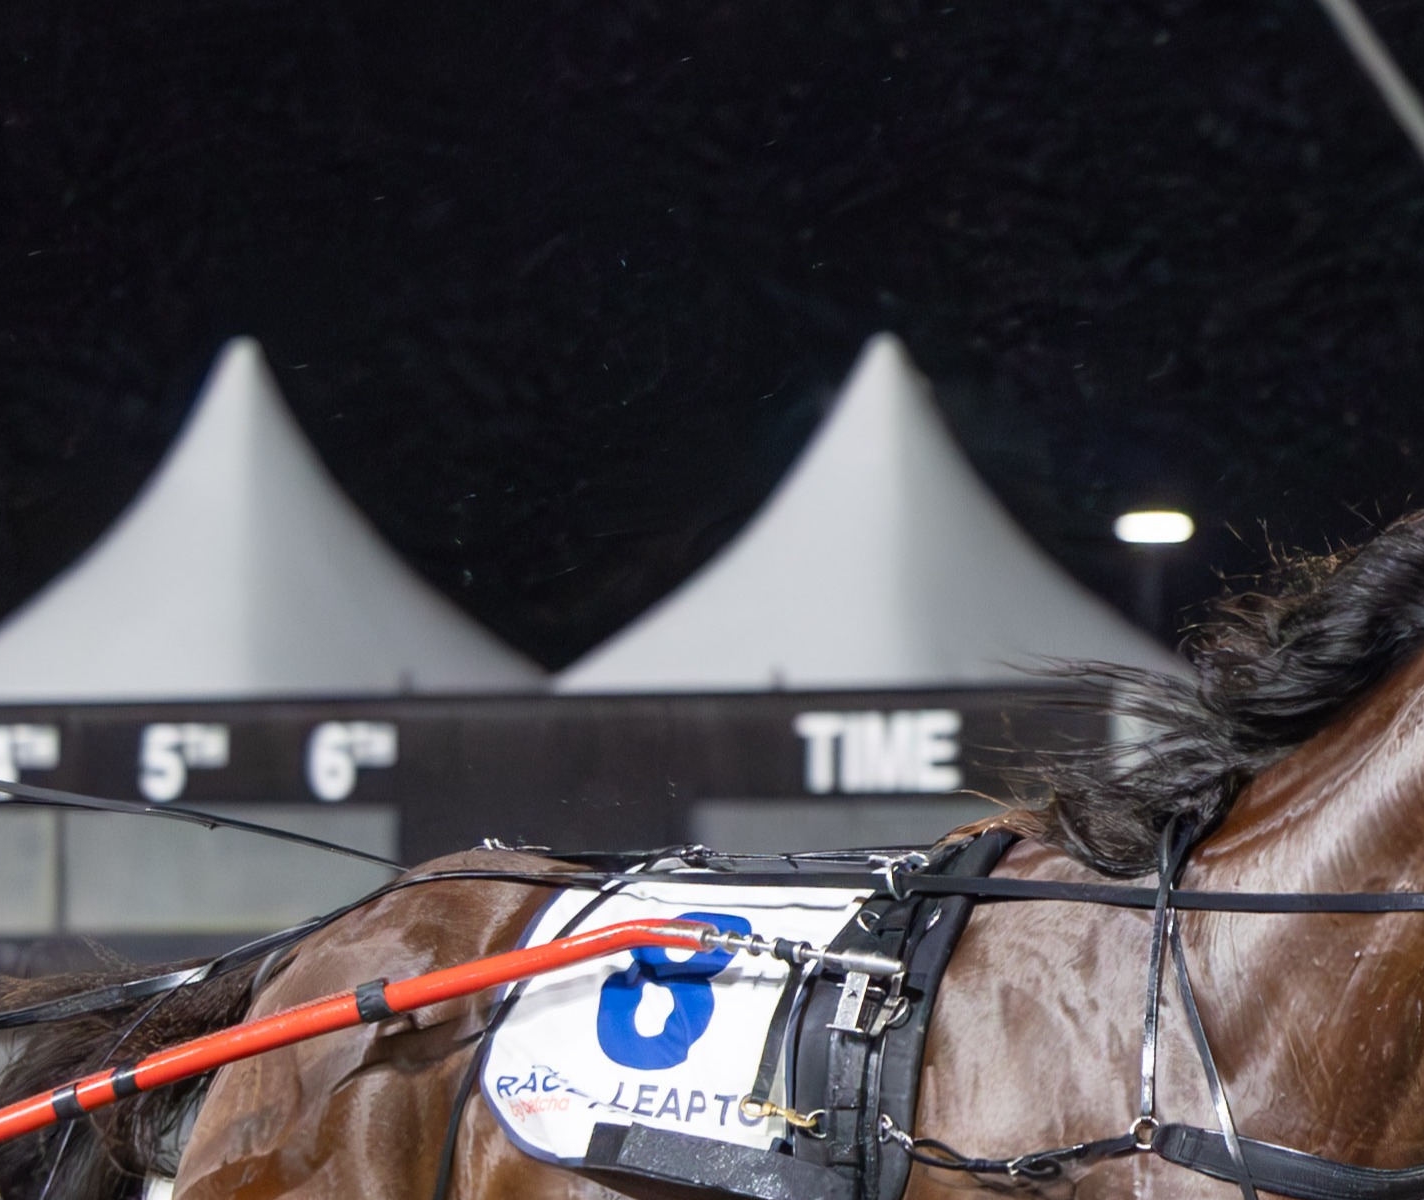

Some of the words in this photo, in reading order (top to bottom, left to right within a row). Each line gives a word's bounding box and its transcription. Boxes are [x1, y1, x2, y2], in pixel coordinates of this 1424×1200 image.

[793, 709, 962, 794] TIME
[597, 912, 752, 1071] 8
[496, 1068, 571, 1099] RAC
